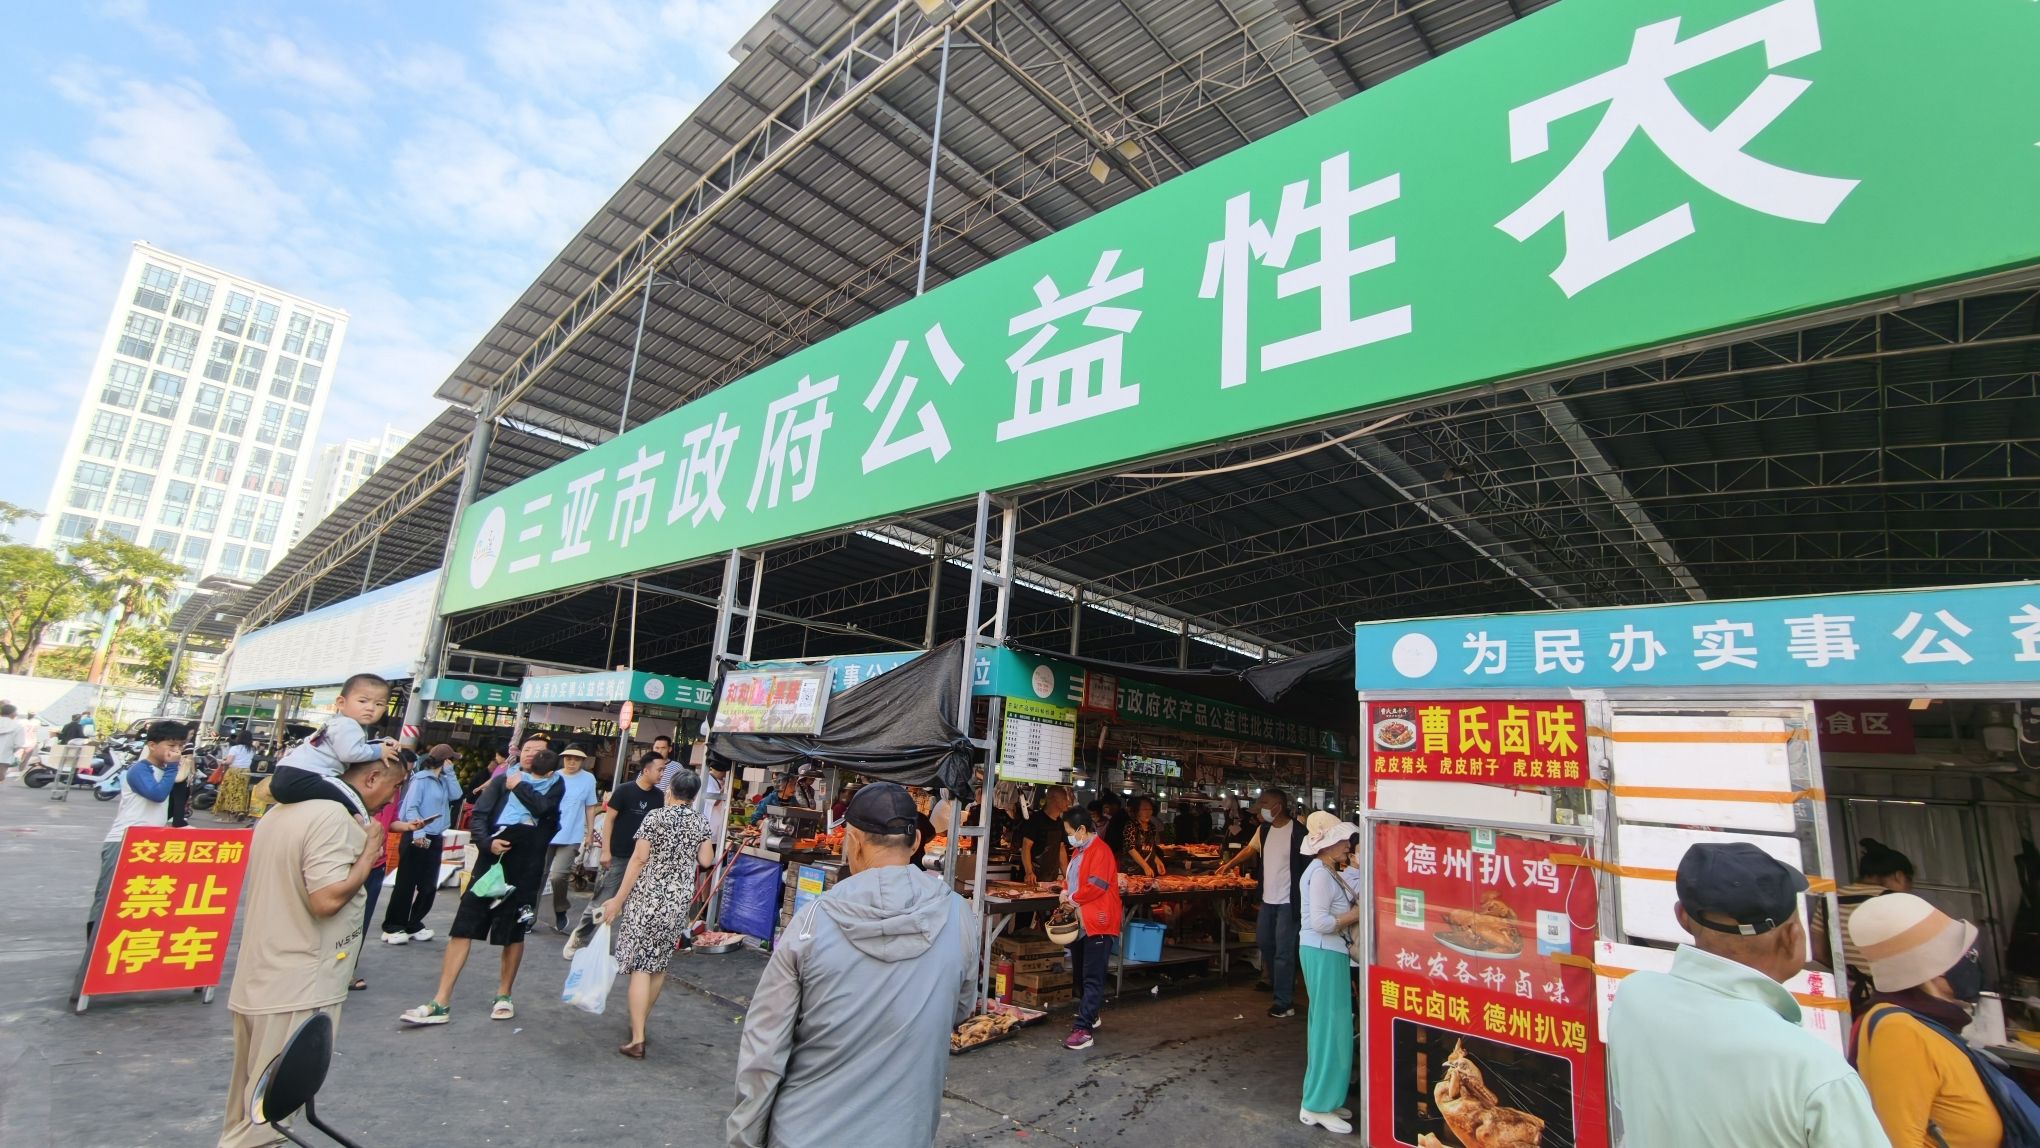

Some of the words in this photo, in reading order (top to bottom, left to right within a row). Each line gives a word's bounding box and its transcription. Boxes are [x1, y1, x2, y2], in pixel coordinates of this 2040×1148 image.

[508, 0, 1862, 574] 三亚市政府公益性农
[675, 684, 714, 706] 三亚
[1418, 704, 1579, 757] 曹氏卤味
[1819, 711, 1892, 735] 食区
[1374, 756, 1428, 774] 虎皮猪头
[1440, 757, 1499, 776] 虎皮肘子
[1513, 758, 1580, 780] 虎皮猪蹄
[128, 840, 244, 864] 交易区前
[1404, 842, 1560, 894] 德州扒鸡
[117, 874, 228, 919] 禁止
[105, 926, 219, 975] 停车
[1395, 948, 1570, 1004] 批发各种卤味
[1380, 980, 1471, 1026] 曹氏卤味
[1483, 1002, 1588, 1053] 德州扒鸡
